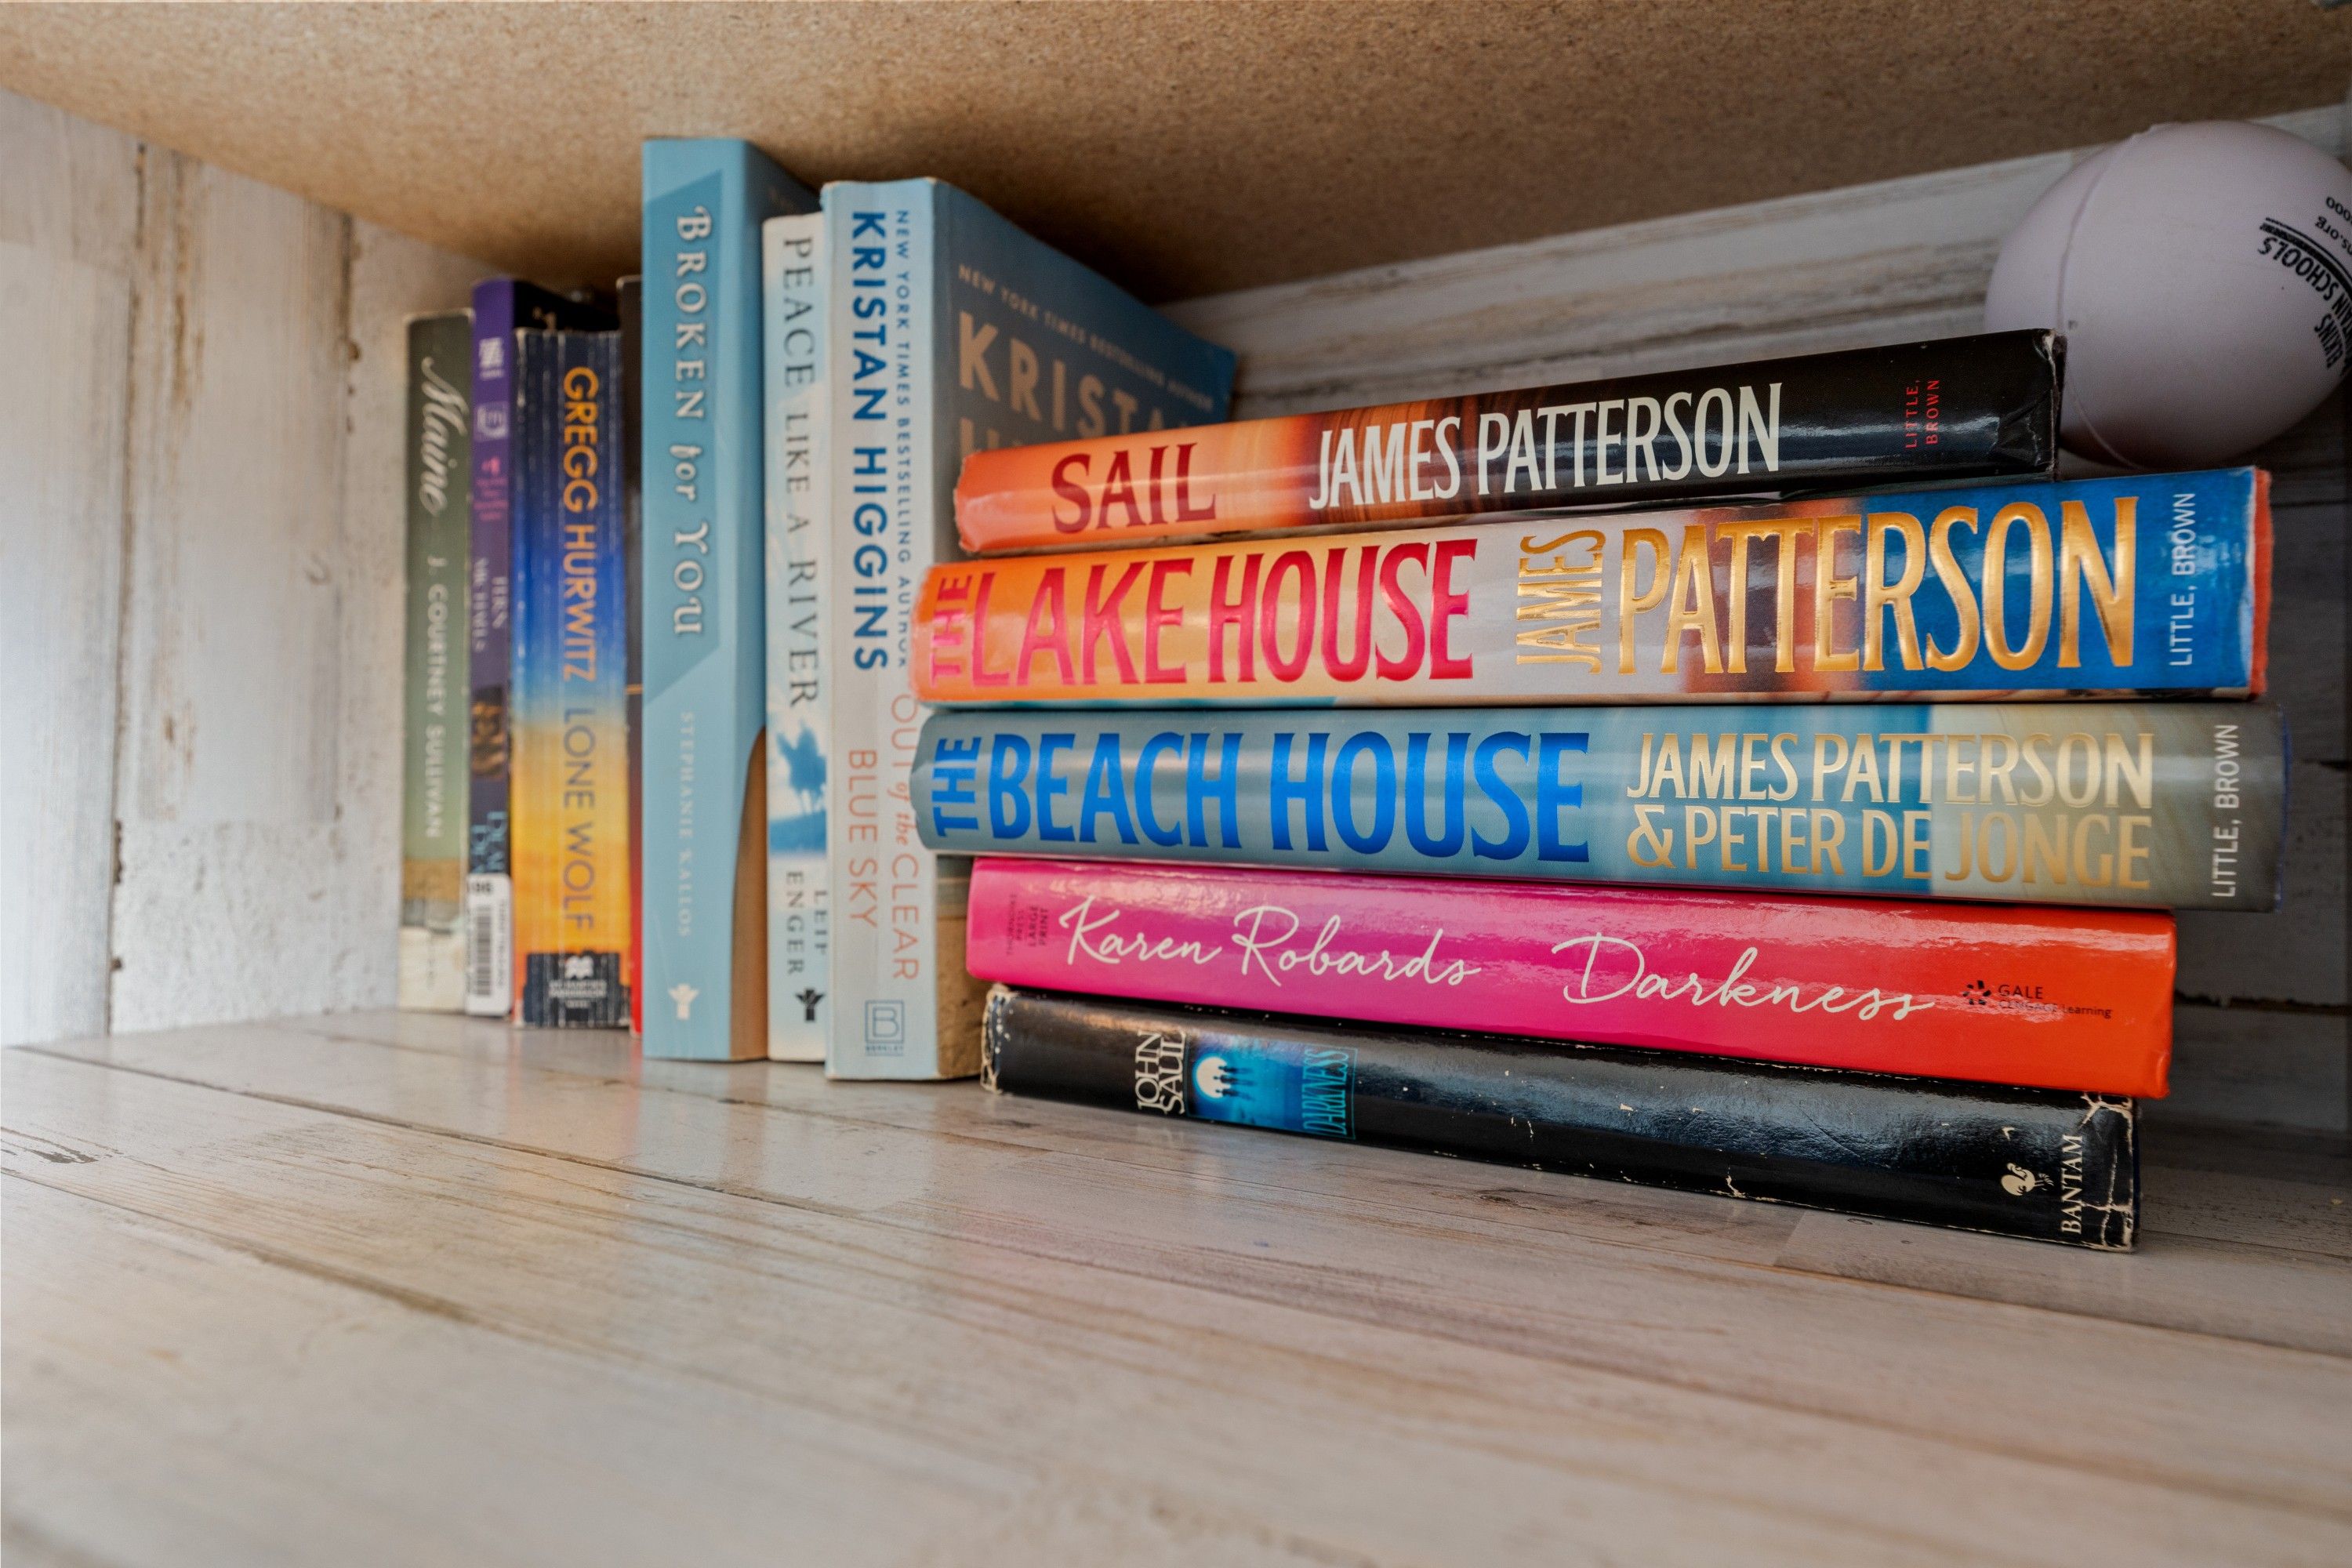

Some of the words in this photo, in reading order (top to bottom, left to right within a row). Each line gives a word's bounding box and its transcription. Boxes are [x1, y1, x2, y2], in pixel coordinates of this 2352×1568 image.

[895, 209, 909, 260] NEW
[958, 263, 996, 296] NEW
[2257, 236, 2339, 301] SCHOOLS
[675, 205, 712, 419] BROKEN
[784, 236, 816, 388] PEACE
[851, 210, 888, 422] KRISTAN
[895, 271, 910, 329] YORK
[896, 342, 911, 407] TIMES
[1905, 379, 1921, 449] LITTLE,
[1926, 379, 1940, 445] BROWN
[419, 356, 469, 517] Maine
[562, 365, 599, 514] GREGG
[669, 443, 702, 501] for
[786, 411, 811, 494] LIKE
[1308, 416, 1461, 510] JAMES
[1477, 382, 1783, 496] PATTERSON
[786, 513, 811, 534] A
[897, 416, 912, 564] BESTSELLING
[1051, 441, 1217, 534] SAIL
[851, 446, 888, 673] HIGGINS
[2171, 492, 2197, 576] BROWN
[562, 523, 597, 682] HURWITZ
[898, 575, 912, 667] AUTHOR
[971, 557, 1196, 688] LAKE
[1207, 538, 1478, 684] HOUSE
[1515, 528, 1606, 675] JAMES
[1617, 495, 2140, 676] PATTERSON
[2169, 585, 2198, 667] LITTLE,
[426, 583, 448, 717] COURTNEY
[787, 558, 820, 707] RIVER
[931, 575, 973, 688] THE
[425, 724, 446, 839] SULLIVAN
[561, 707, 597, 811] LONE
[679, 711, 695, 840] STEPHANIE
[848, 749, 879, 844] BLUE
[931, 735, 982, 838] THE
[988, 730, 1246, 851] BEACH
[1269, 730, 1591, 863] HOUSE
[1626, 731, 1798, 802] JAMES
[1809, 732, 2155, 810] PATTERSON
[2214, 724, 2241, 810] BROWN
[895, 811, 917, 846] the
[1626, 804, 1678, 869] &
[1684, 804, 1847, 877] PETER
[1860, 809, 1934, 880] DE
[1944, 811, 2154, 891] JONGE
[2211, 819, 2242, 898] LITTLE,
[561, 821, 597, 931] WOLF
[678, 850, 693, 938] KALLOS
[848, 855, 879, 931] SKY
[891, 852, 920, 980] CLEAR
[786, 871, 804, 975] ENGER
[815, 890, 828, 955] LEIF
[1028, 905, 1038, 948] LARGE
[1039, 908, 1048, 946] PRINT
[1058, 893, 1222, 965] Karen
[1232, 904, 1482, 987] Robards
[1551, 931, 1935, 1021] Darkness
[1998, 984, 2044, 1000] GALE
[2061, 1004, 2112, 1019] Learning
[1134, 1030, 1163, 1111] JOHN
[1156, 1029, 1187, 1115] SAUL
[1300, 1047, 1350, 1136] DARKNESS
[2060, 1132, 2084, 1236] BANTAM
